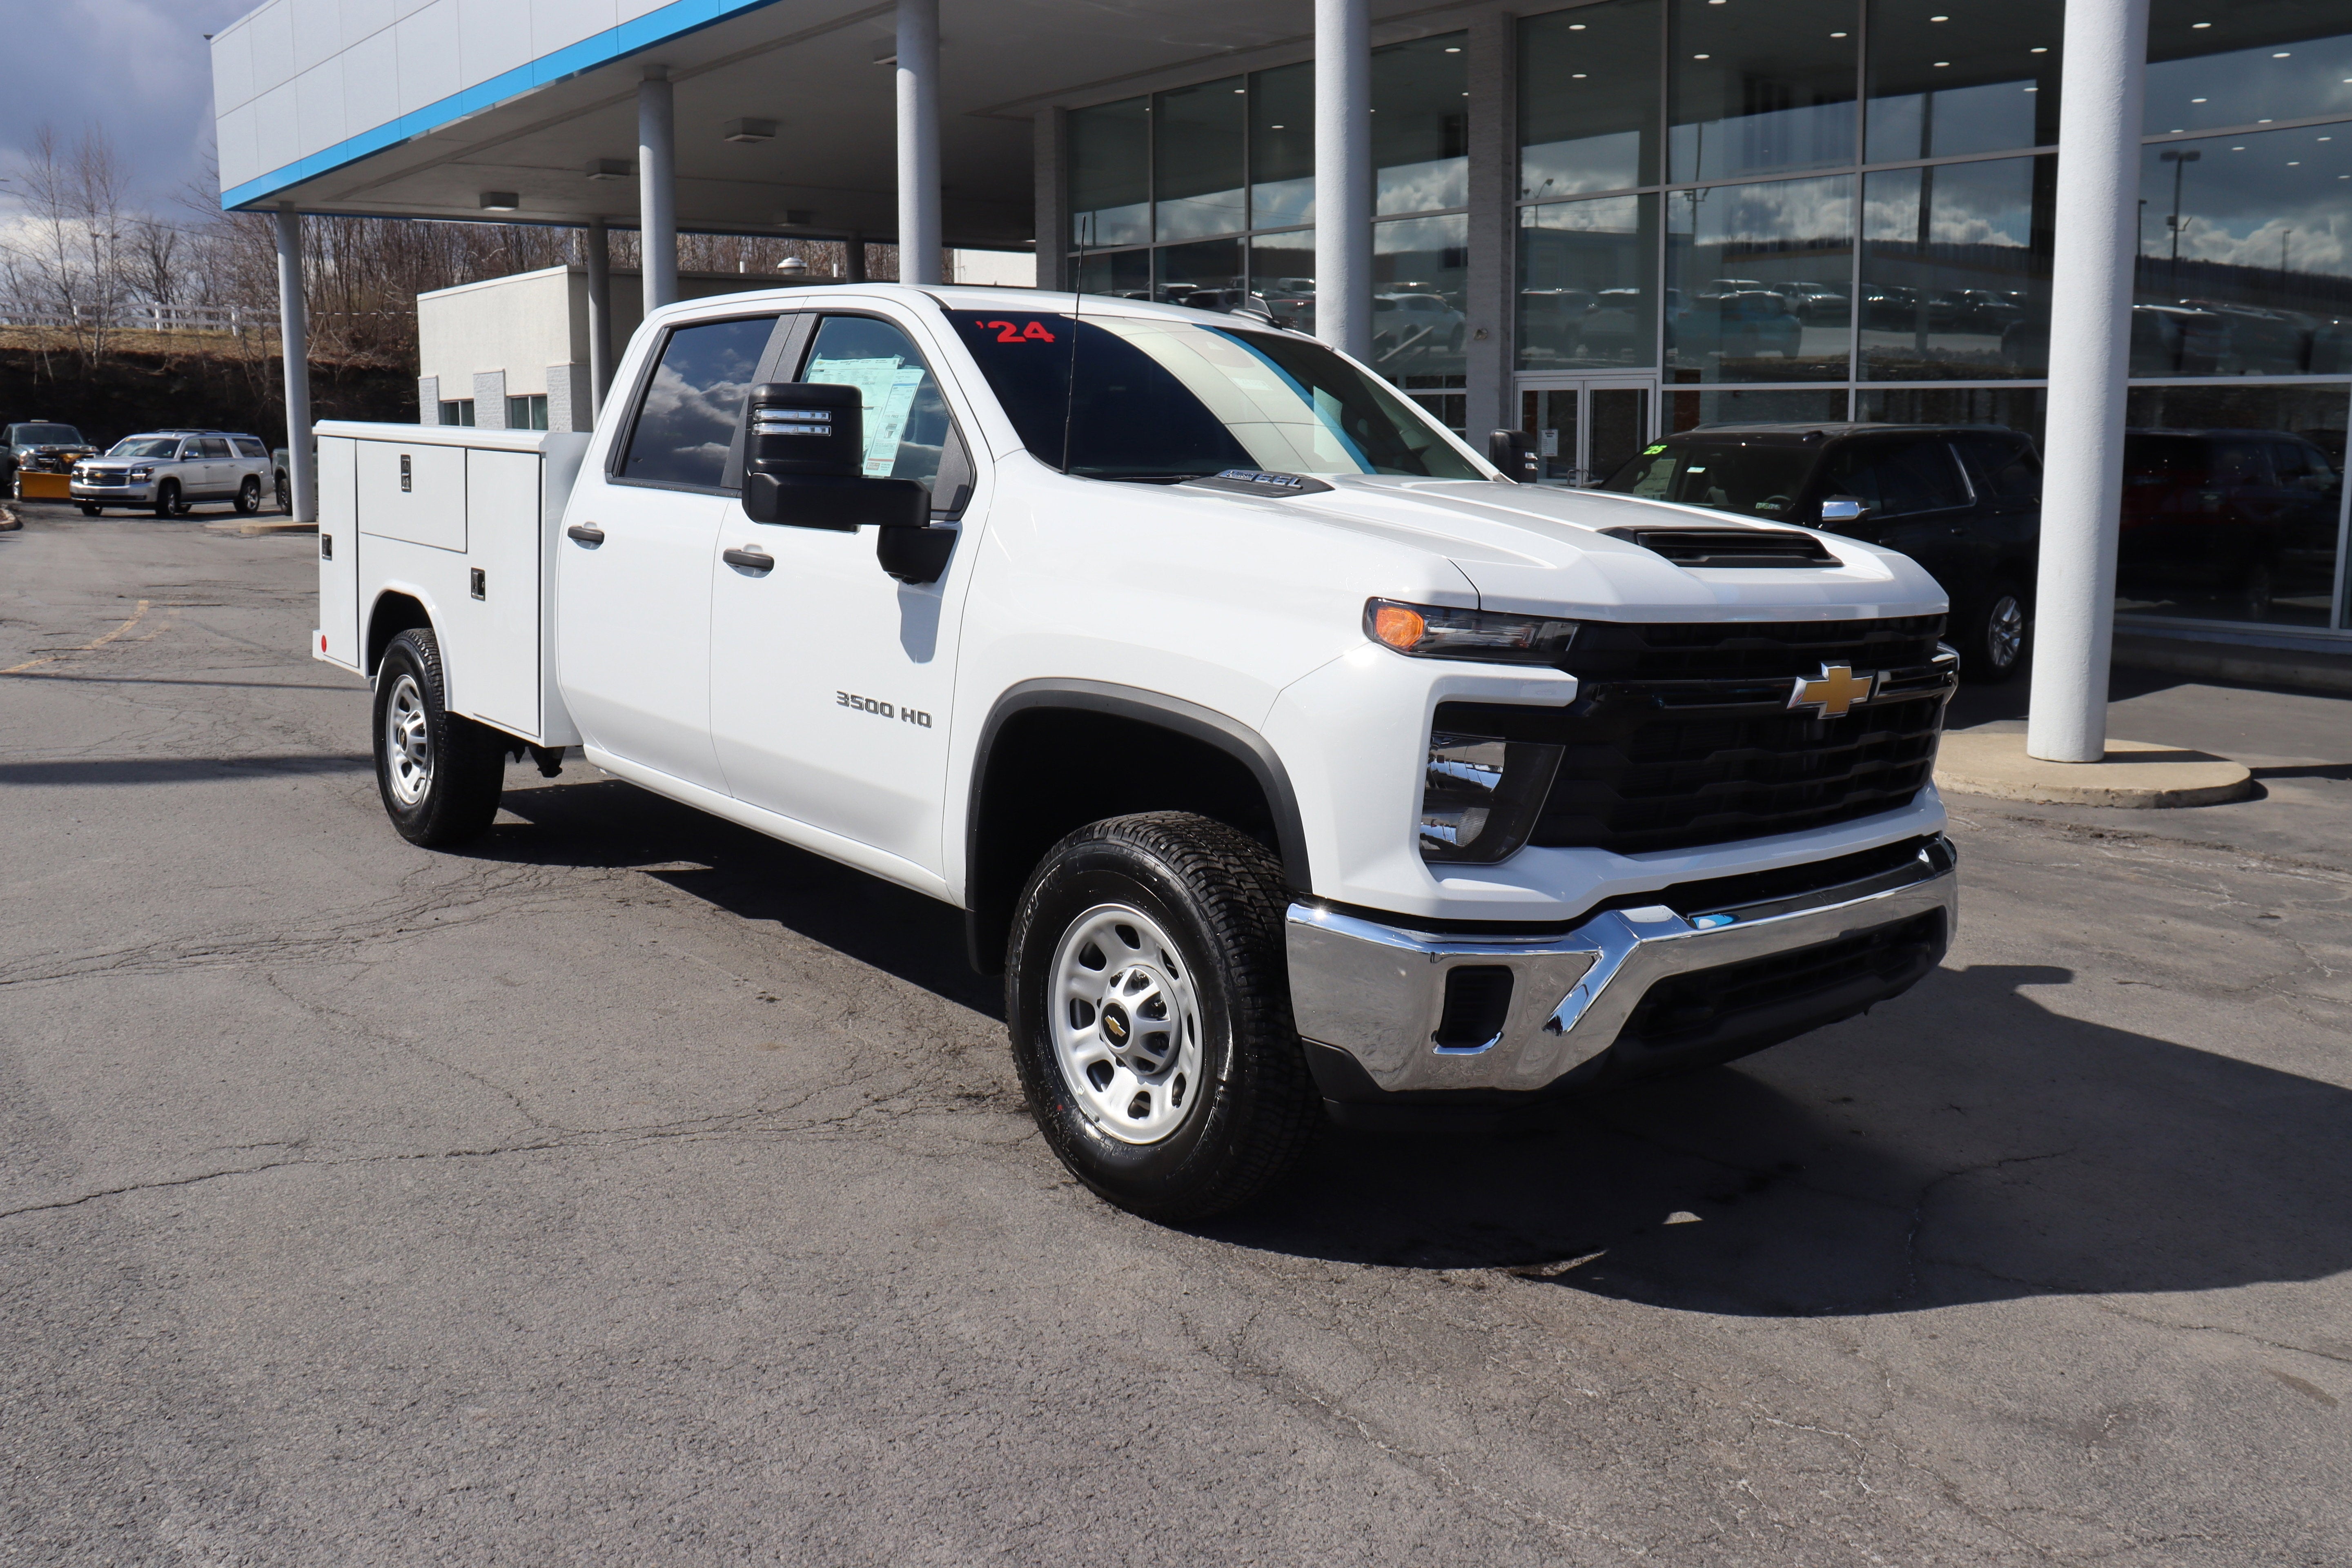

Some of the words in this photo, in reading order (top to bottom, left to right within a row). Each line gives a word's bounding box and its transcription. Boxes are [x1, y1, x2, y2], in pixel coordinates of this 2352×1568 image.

[975, 321, 1056, 343] '24
[836, 690, 894, 719] 3500
[901, 706, 933, 728] HD
